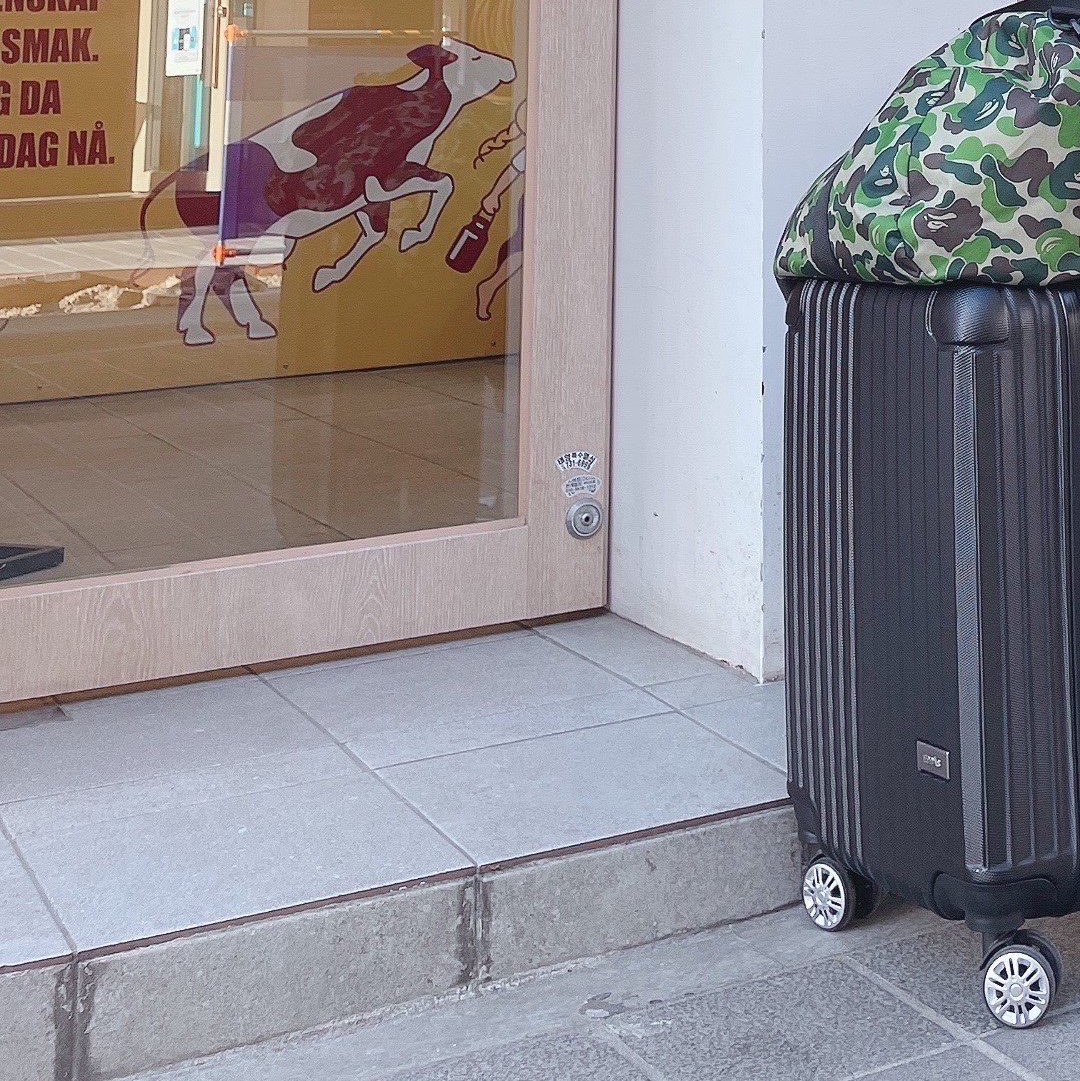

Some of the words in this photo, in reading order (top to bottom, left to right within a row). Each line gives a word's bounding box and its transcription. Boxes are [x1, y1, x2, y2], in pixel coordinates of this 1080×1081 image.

[1, 28, 99, 64] SMAK.
[19, 79, 61, 115] DA
[67, 121, 115, 167] NÅ.
